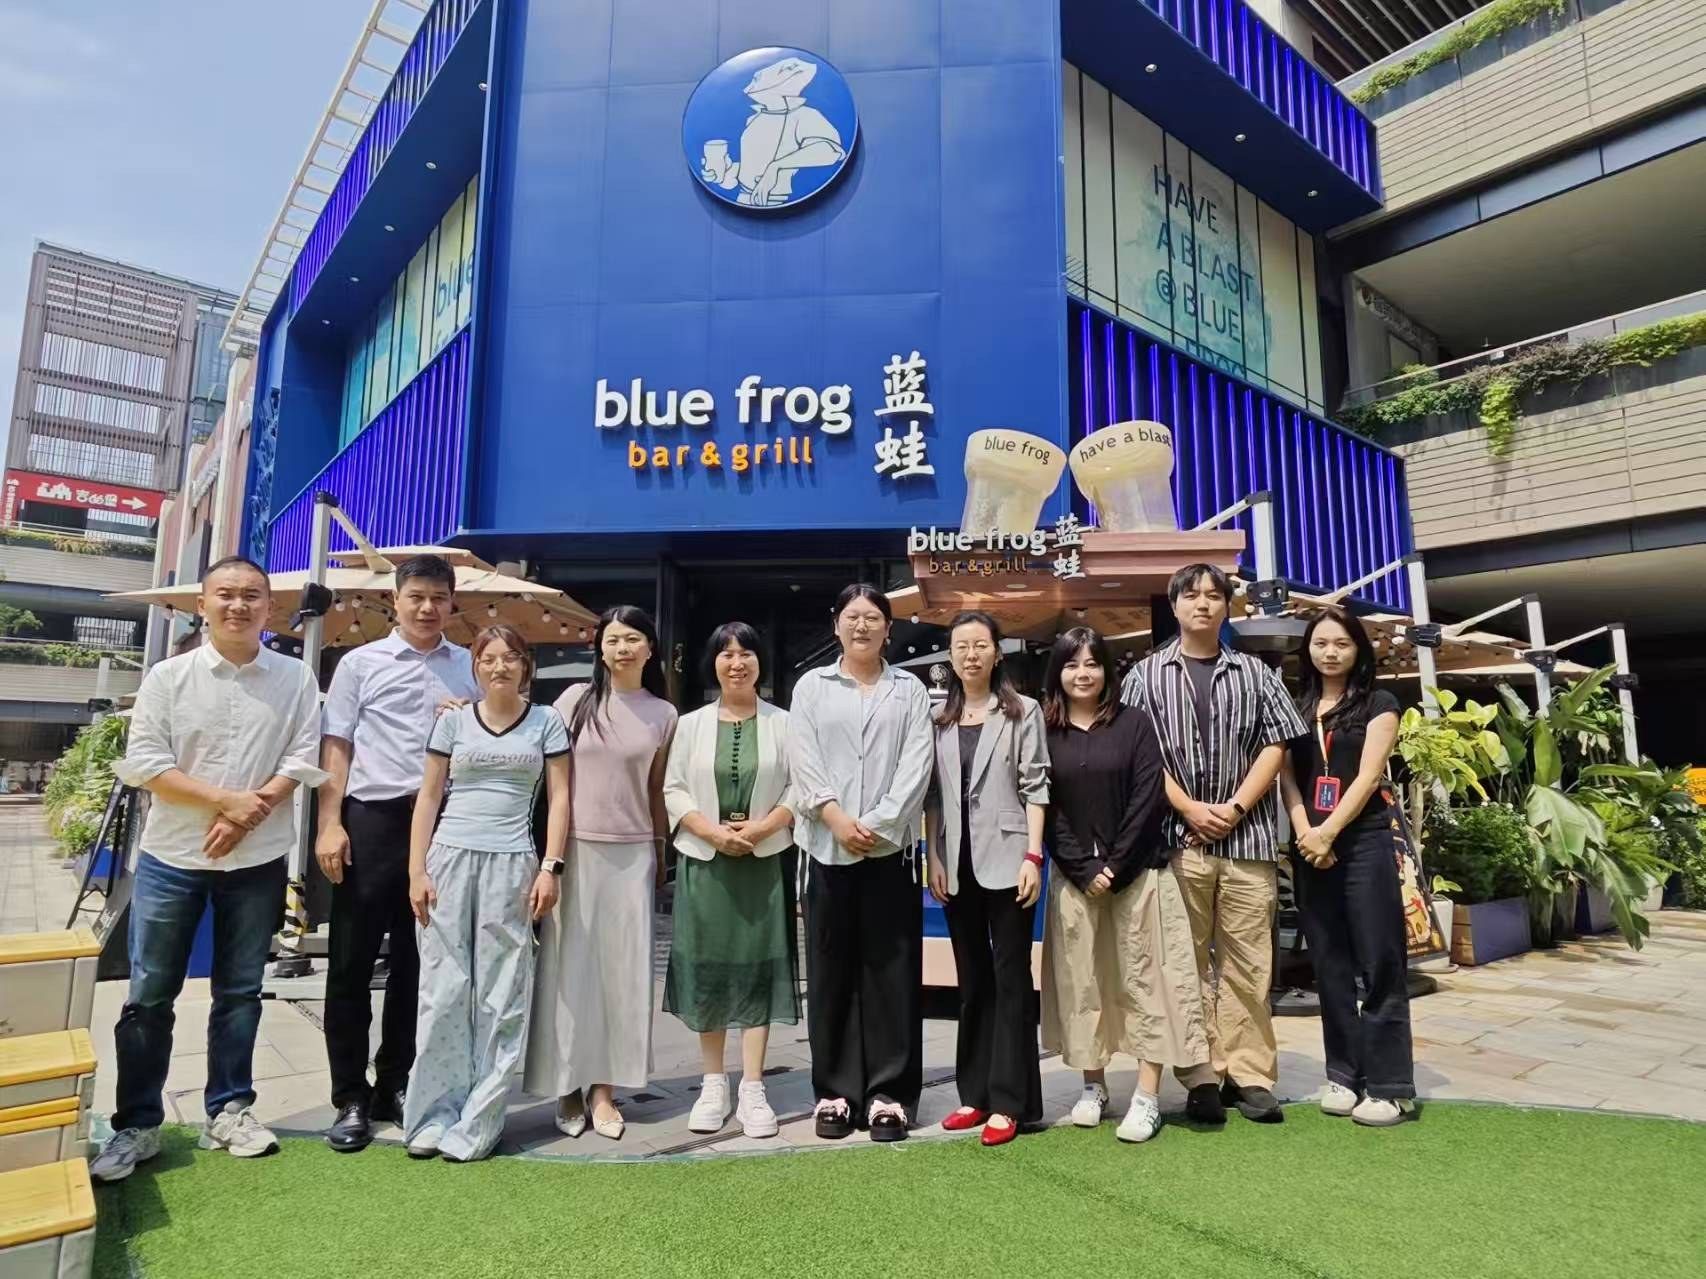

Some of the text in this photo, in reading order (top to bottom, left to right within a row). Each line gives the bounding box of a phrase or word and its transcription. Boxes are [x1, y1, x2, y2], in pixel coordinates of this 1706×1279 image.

[1153, 164, 1219, 234] HAVE
[1156, 222, 1255, 301] A BLAST
[1156, 269, 1241, 343] @ BLUE
[595, 375, 852, 435] blue frog
[874, 350, 934, 480] 蓝蛙
[628, 437, 813, 472] bar & grill
[984, 436, 1050, 465] blue frog
[1080, 437, 1116, 463] have
[1124, 432, 1134, 443] a
[911, 526, 1047, 556] blue frog
[929, 557, 961, 573] bar
[981, 556, 1027, 576] grill
[1052, 512, 1086, 580] 蓝蛙
